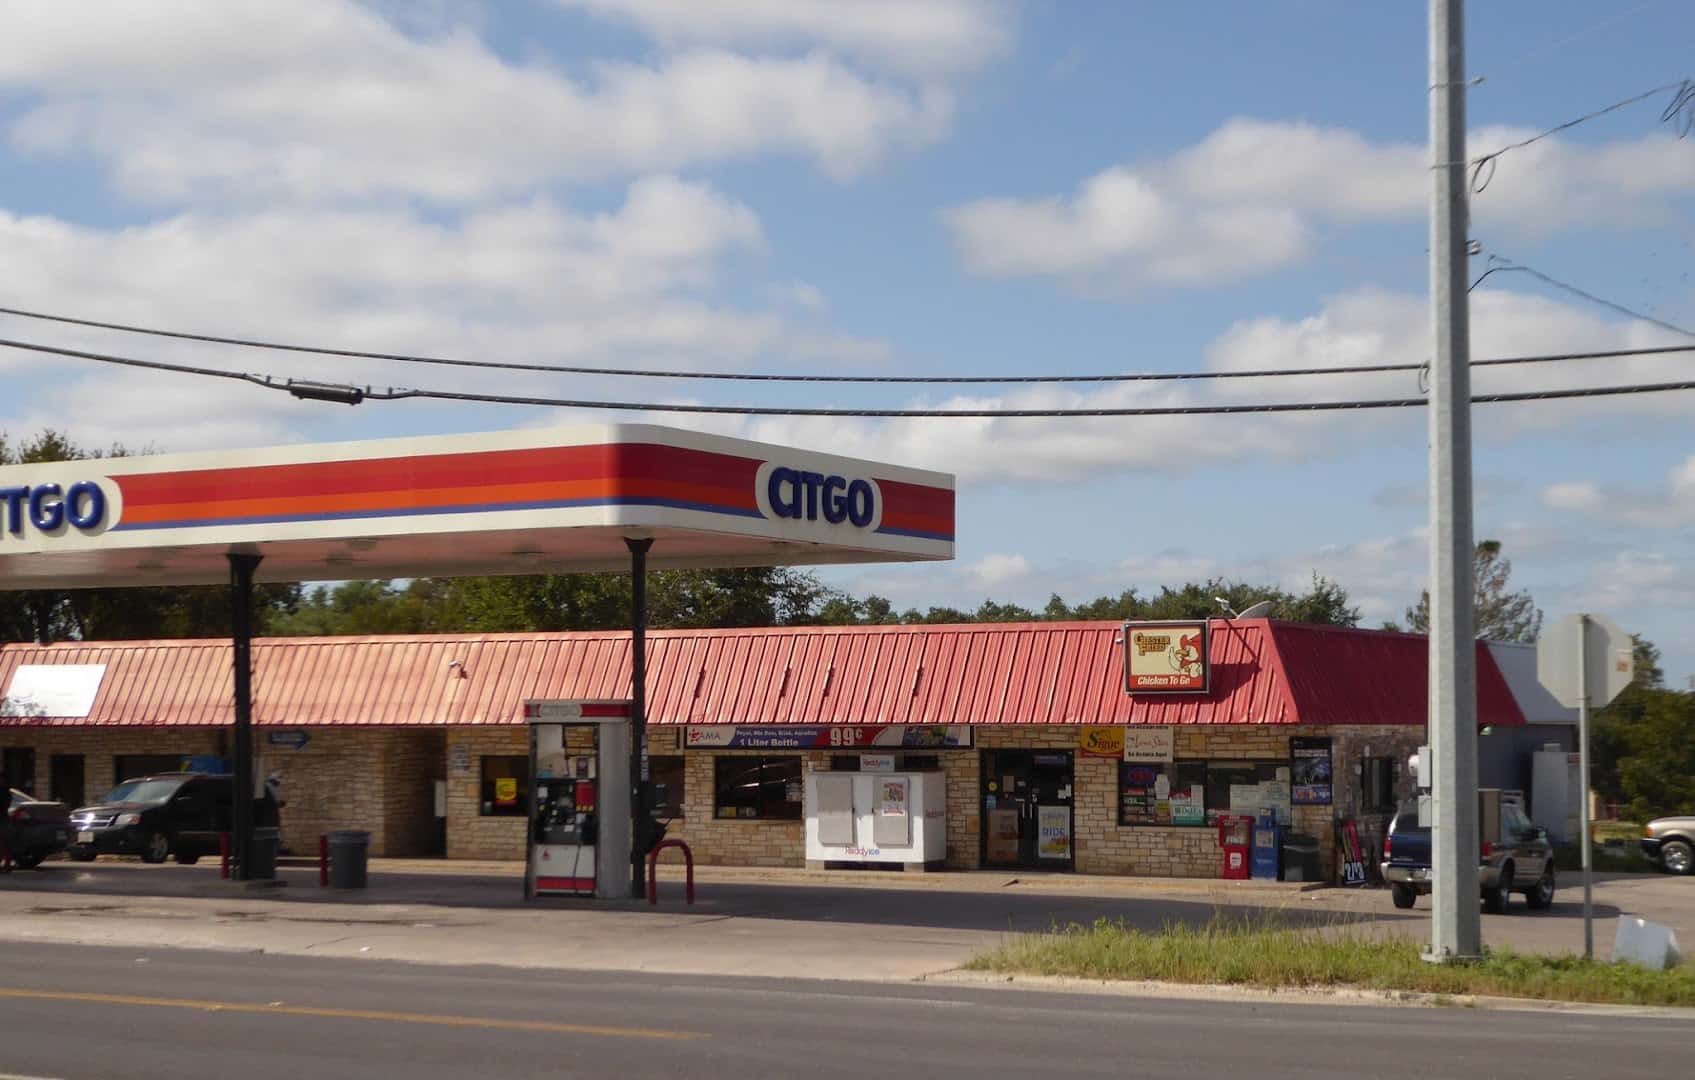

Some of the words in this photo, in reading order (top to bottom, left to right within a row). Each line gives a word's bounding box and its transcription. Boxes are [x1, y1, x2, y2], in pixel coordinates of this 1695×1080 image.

[768, 467, 874, 528] CITGO
[1137, 675, 1168, 686] Chicken
[1169, 675, 1179, 686] To
[1180, 675, 1191, 686] Go
[748, 738, 769, 746] Liter
[770, 738, 799, 746] Bottle
